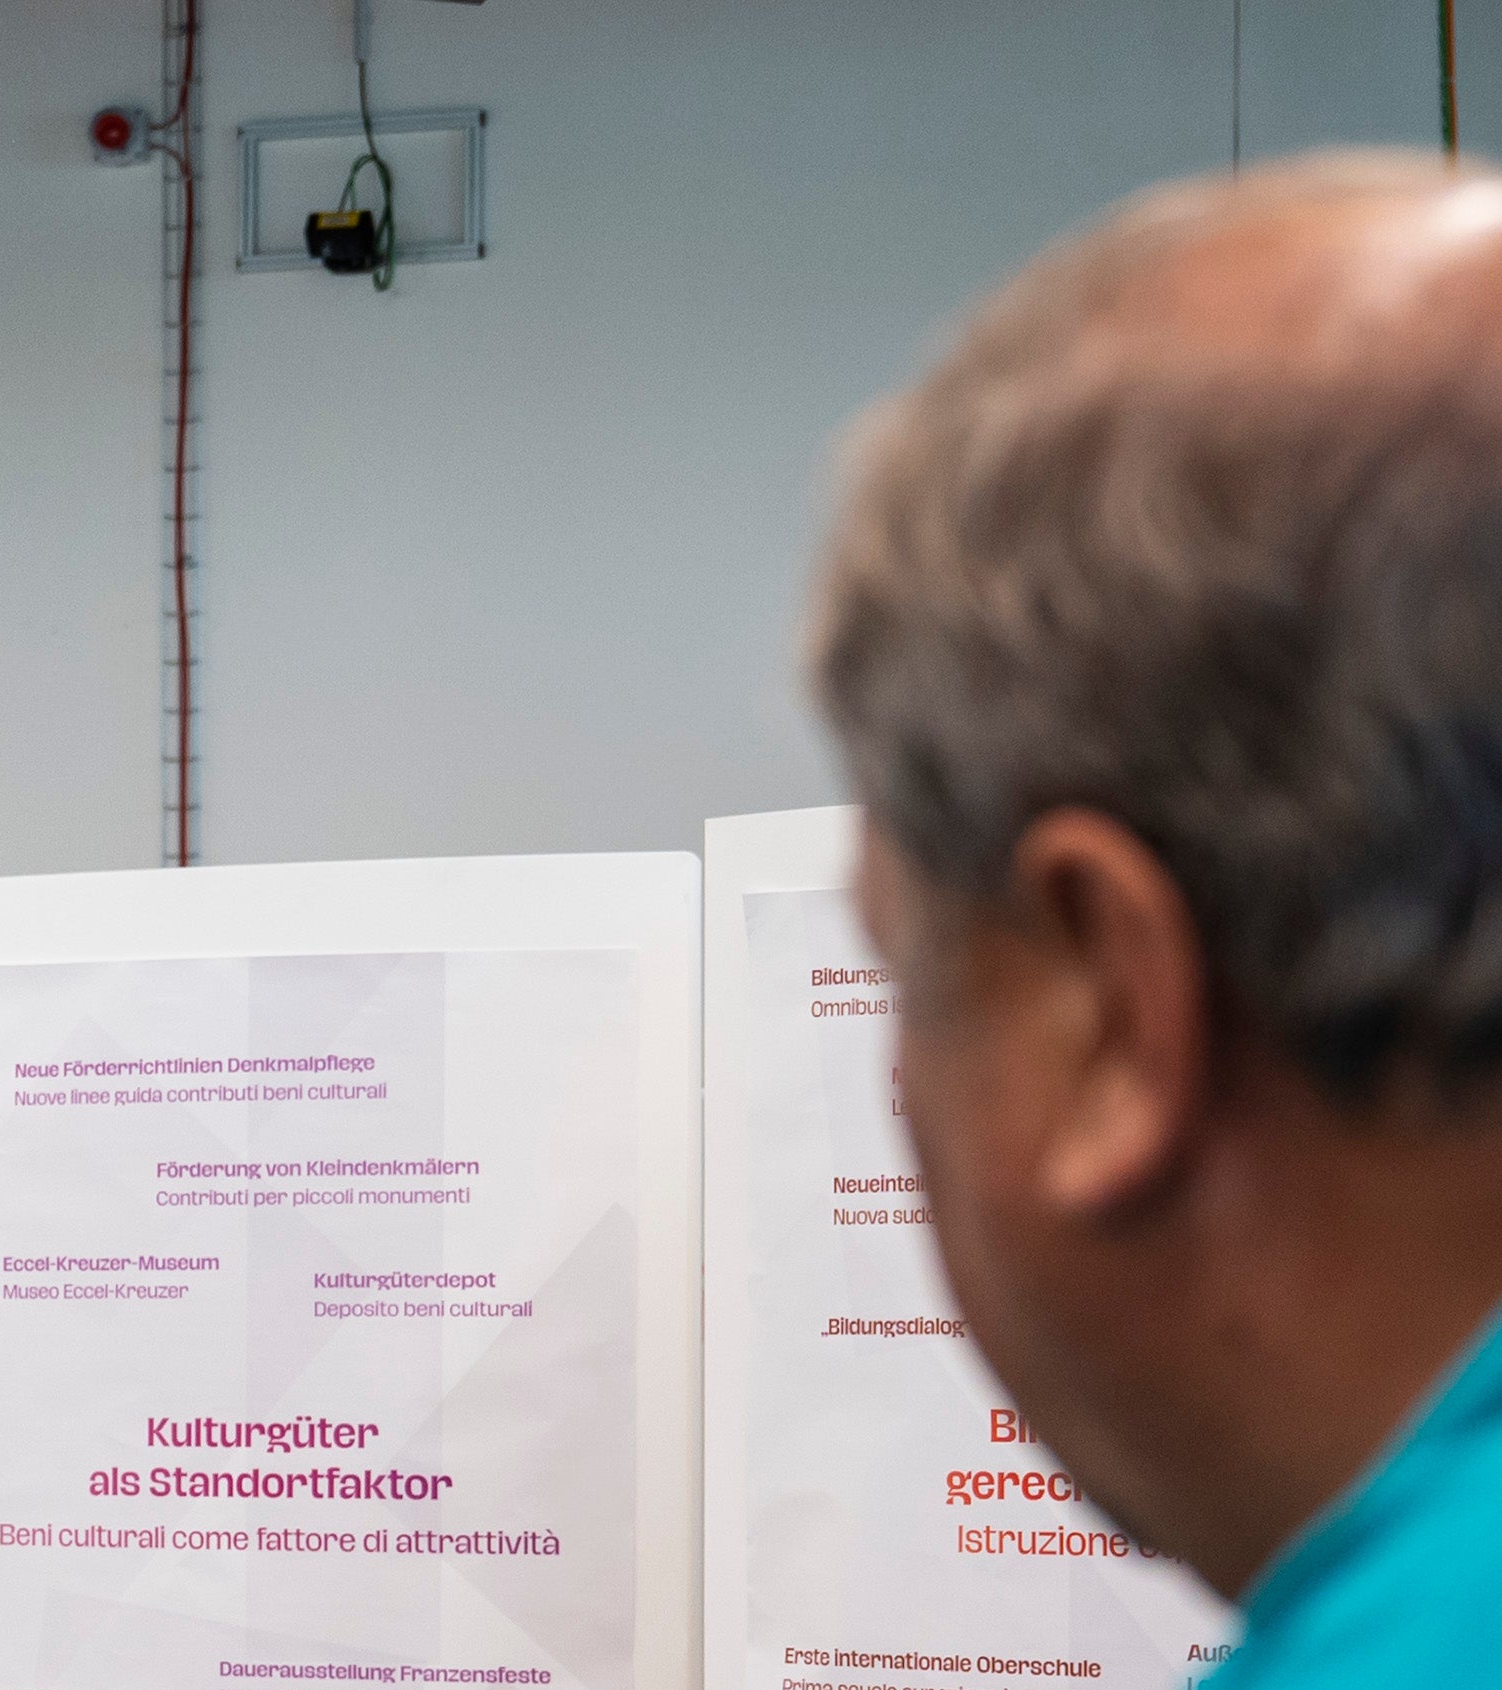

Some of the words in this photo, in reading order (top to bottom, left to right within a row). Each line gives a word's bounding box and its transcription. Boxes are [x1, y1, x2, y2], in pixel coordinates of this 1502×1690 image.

[811, 998, 889, 1018] Omnibus
[14, 1063, 60, 1079] Neue
[62, 1056, 224, 1078] Förderrichtlinien
[227, 1054, 376, 1074] Denkmalpflege
[13, 1090, 67, 1107] Nuove
[69, 1088, 111, 1105] linee
[113, 1086, 164, 1107] guida
[165, 1083, 260, 1104] contributi
[262, 1083, 304, 1102] beni
[306, 1081, 388, 1101] culturali
[156, 1160, 263, 1180] Förderung
[265, 1162, 302, 1178] von
[306, 1157, 480, 1177] Kleindenkmälern
[155, 1188, 250, 1207] Contributi
[252, 1191, 289, 1208] per
[292, 1187, 355, 1208] piccoli
[357, 1186, 471, 1205] monumenti
[833, 1207, 889, 1226] Nuova
[2, 1255, 220, 1273] Eccel-Kreuzer-Museum
[2, 1283, 60, 1300] Museo
[62, 1283, 190, 1300] Eccel-Kreuzer
[313, 1271, 497, 1291] Kulturgüterdepot
[313, 1300, 400, 1320] Deposito
[403, 1300, 445, 1318] beni
[449, 1299, 534, 1318] culturali
[147, 1415, 380, 1454] Kulturgüter
[88, 1466, 141, 1497] als
[148, 1466, 454, 1501] Standortfaktor
[0, 1523, 53, 1547] Beni
[58, 1525, 166, 1549] culturali
[171, 1530, 250, 1551] come
[256, 1526, 357, 1553] fattore
[362, 1528, 389, 1553] di
[395, 1528, 561, 1556] attrattività
[958, 1525, 1129, 1558] Istruzione
[219, 1660, 397, 1684] Dauerausstellung
[399, 1665, 552, 1685] Franzensfeste
[784, 1647, 831, 1667] Erste
[833, 1647, 972, 1673] internationale
[976, 1655, 1102, 1679] Oberschule
